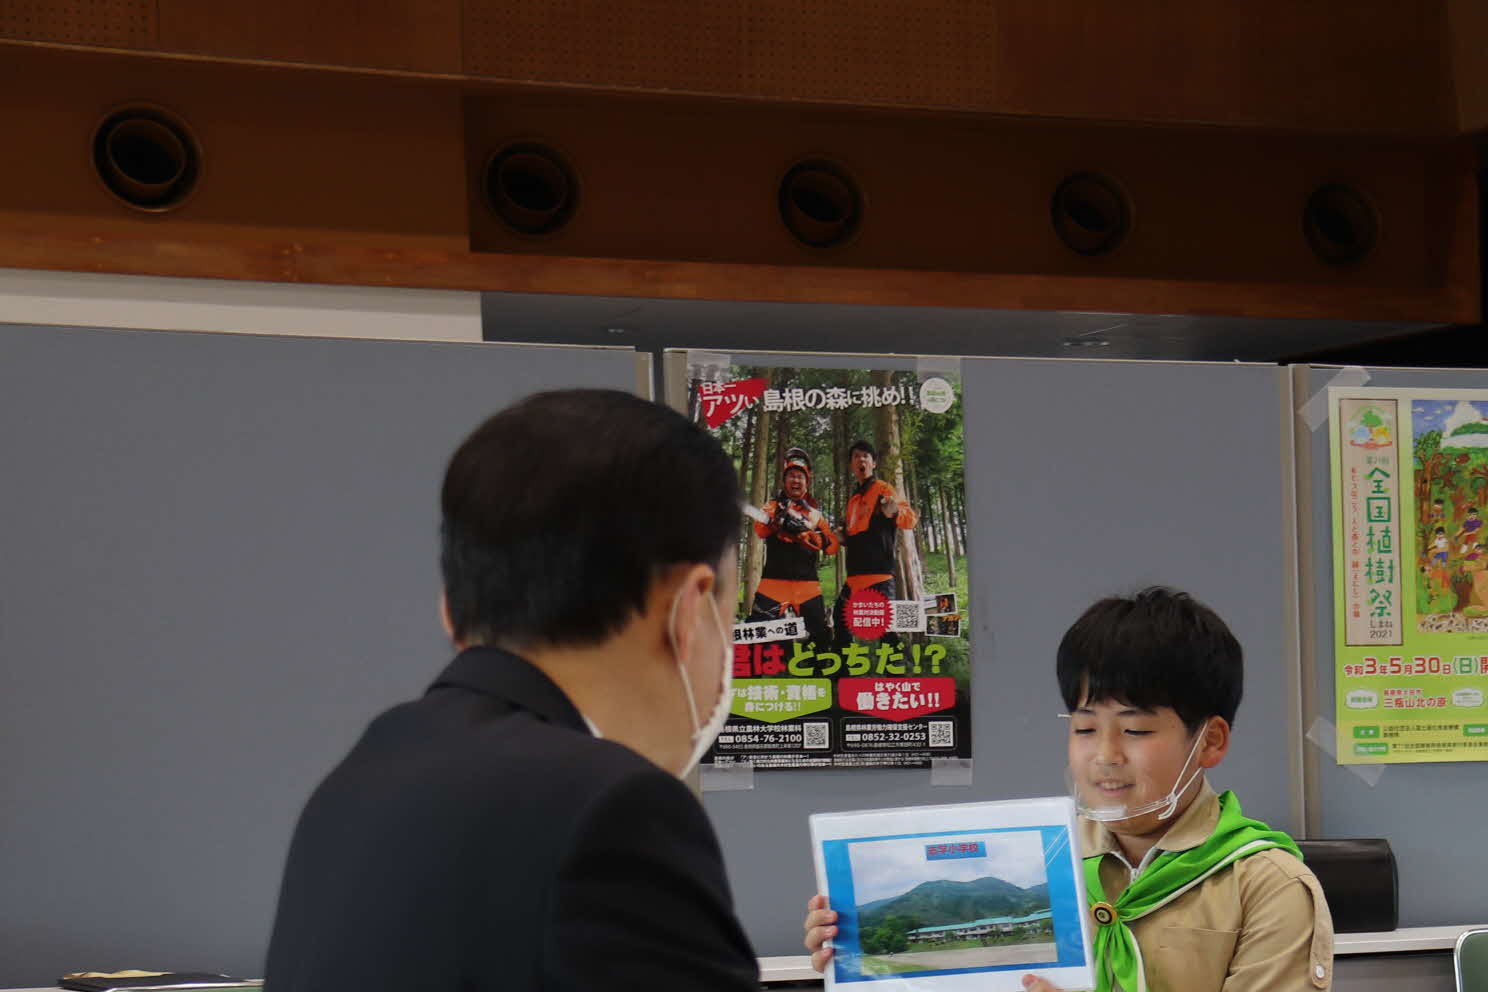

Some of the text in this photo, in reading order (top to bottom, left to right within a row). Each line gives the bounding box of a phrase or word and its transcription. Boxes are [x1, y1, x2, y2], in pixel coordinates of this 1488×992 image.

[702, 382, 737, 394] 日本一
[1364, 467, 1393, 617] 全国植樹祭
[1369, 619, 1393, 629] しまね
[1369, 629, 1393, 639] 2021
[874, 681, 921, 692] はやく山で
[735, 734, 802, 743] 0854-76-2100
[862, 733, 927, 741] 0852-32-0253
